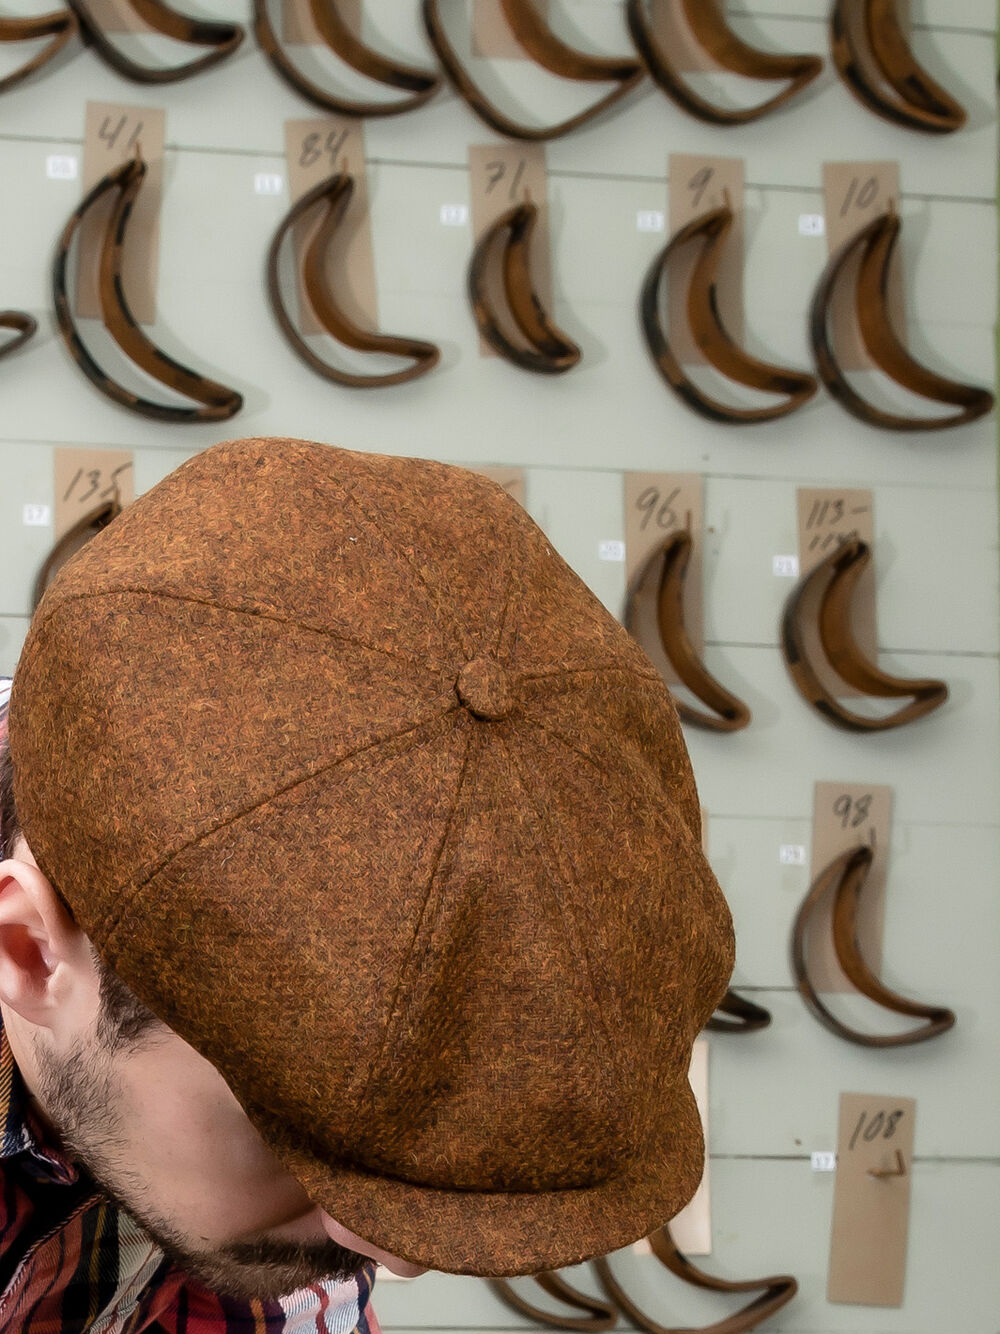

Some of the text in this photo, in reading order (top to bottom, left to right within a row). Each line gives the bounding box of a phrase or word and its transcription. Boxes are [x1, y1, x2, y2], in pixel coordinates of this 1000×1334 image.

[98, 115, 144, 150] 41
[298, 127, 349, 168] 84
[485, 160, 526, 200] 71
[840, 176, 880, 217] 10
[62, 460, 134, 502] 135
[635, 485, 681, 531] 96
[832, 793, 873, 829] 98
[849, 1109, 905, 1151] 108
